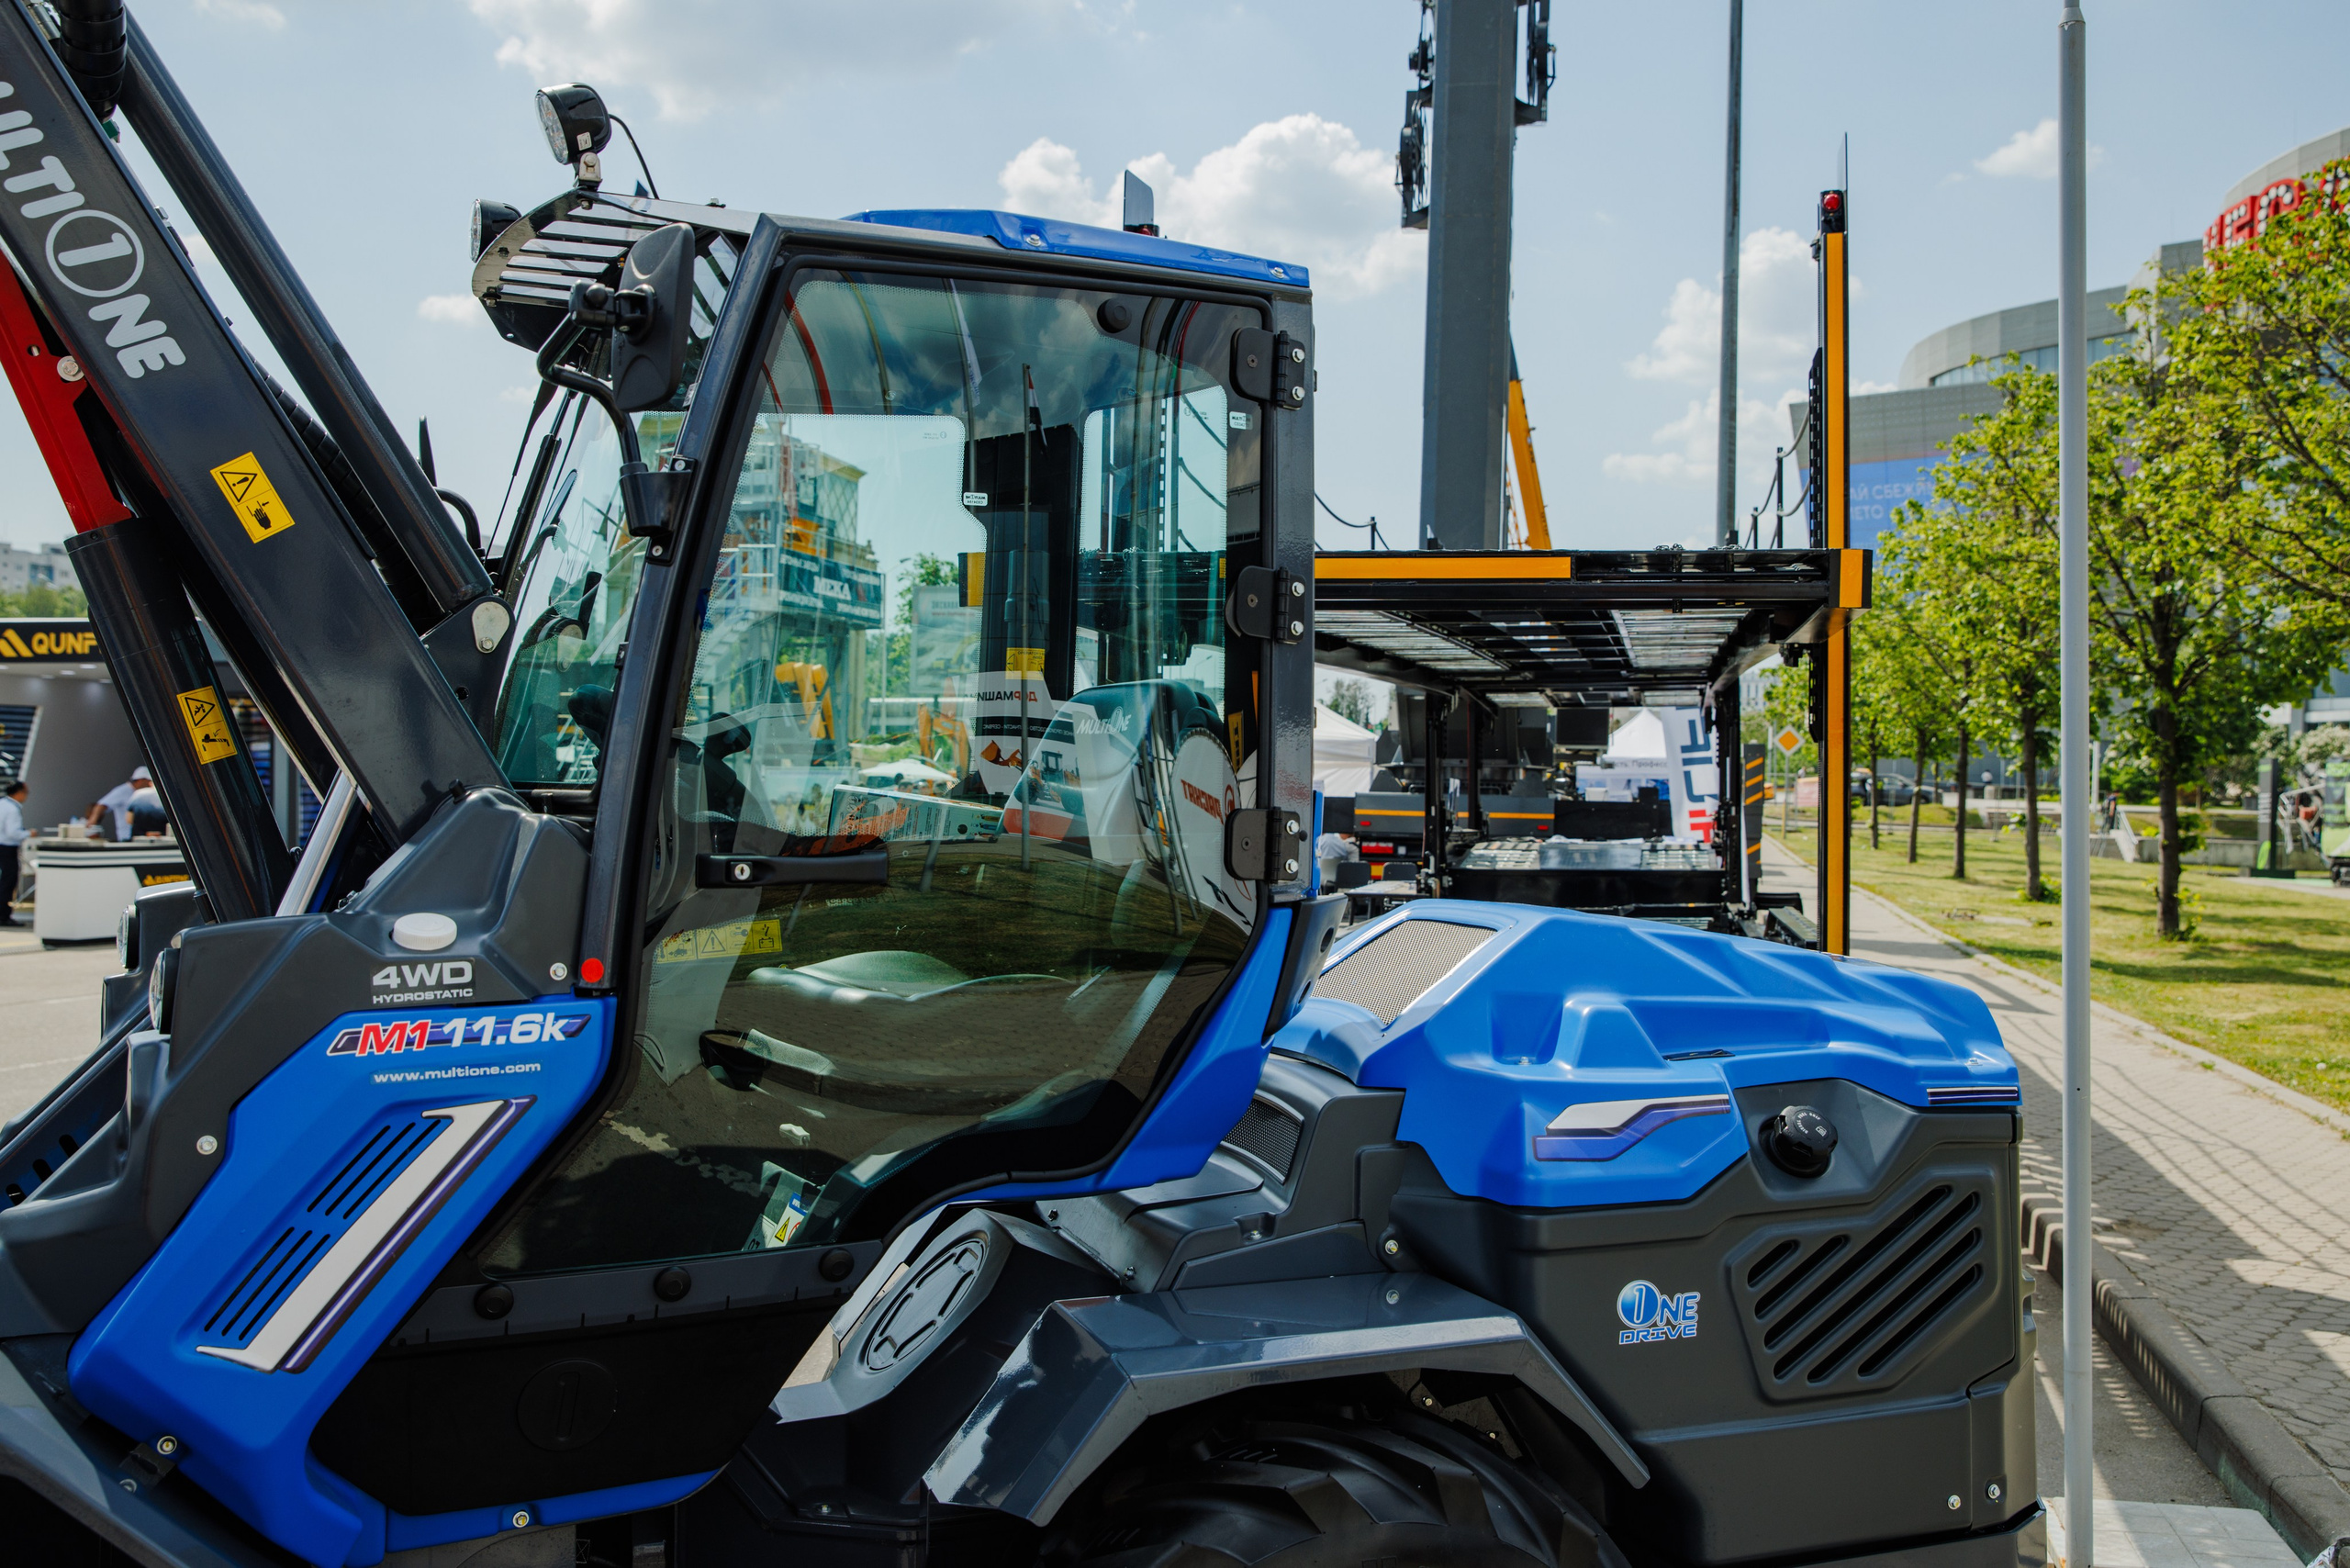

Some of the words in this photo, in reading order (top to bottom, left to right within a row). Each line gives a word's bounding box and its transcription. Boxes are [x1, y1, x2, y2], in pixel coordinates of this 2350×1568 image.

[812, 575, 852, 601] MEKA
[31, 631, 102, 655] QUNF
[1076, 706, 1132, 734] MULTIONE
[1632, 760, 1668, 768] Професс
[372, 960, 473, 989] 4WD
[372, 988, 474, 1004] HYDROSTATIC
[355, 1019, 431, 1057] M1
[442, 1012, 569, 1047] 11.6k
[374, 1061, 542, 1083] www.multione.com
[1617, 1279, 1701, 1328] ONE
[1618, 1322, 1698, 1345] DRIVE
